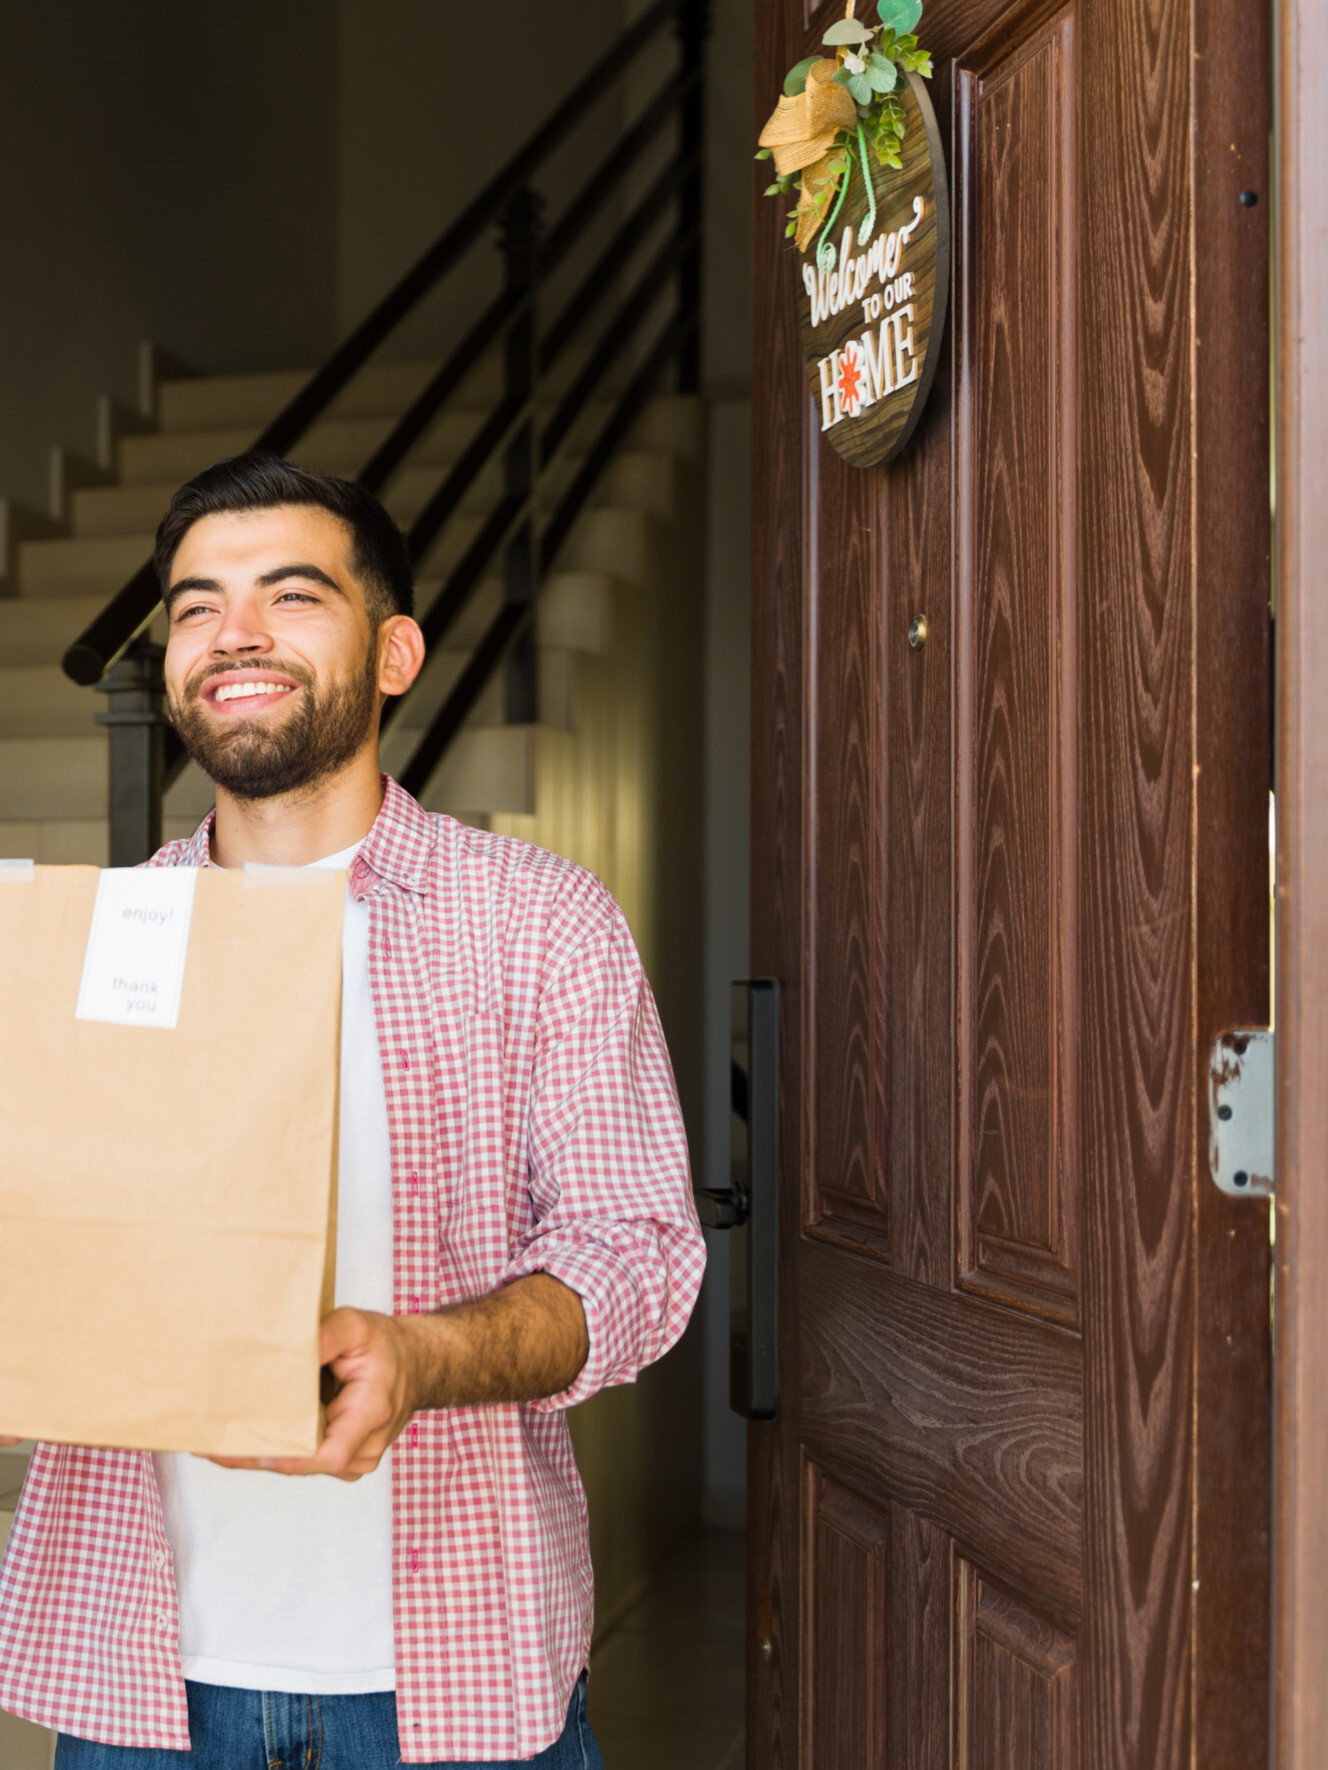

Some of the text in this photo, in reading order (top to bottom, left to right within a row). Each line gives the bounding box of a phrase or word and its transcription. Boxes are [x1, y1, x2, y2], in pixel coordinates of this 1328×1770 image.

[802, 196, 923, 327] Welcome
[861, 272, 916, 324] TO OUR
[122, 907, 174, 925] enjoy!
[112, 977, 159, 994] thank
[126, 999, 157, 1013] you
